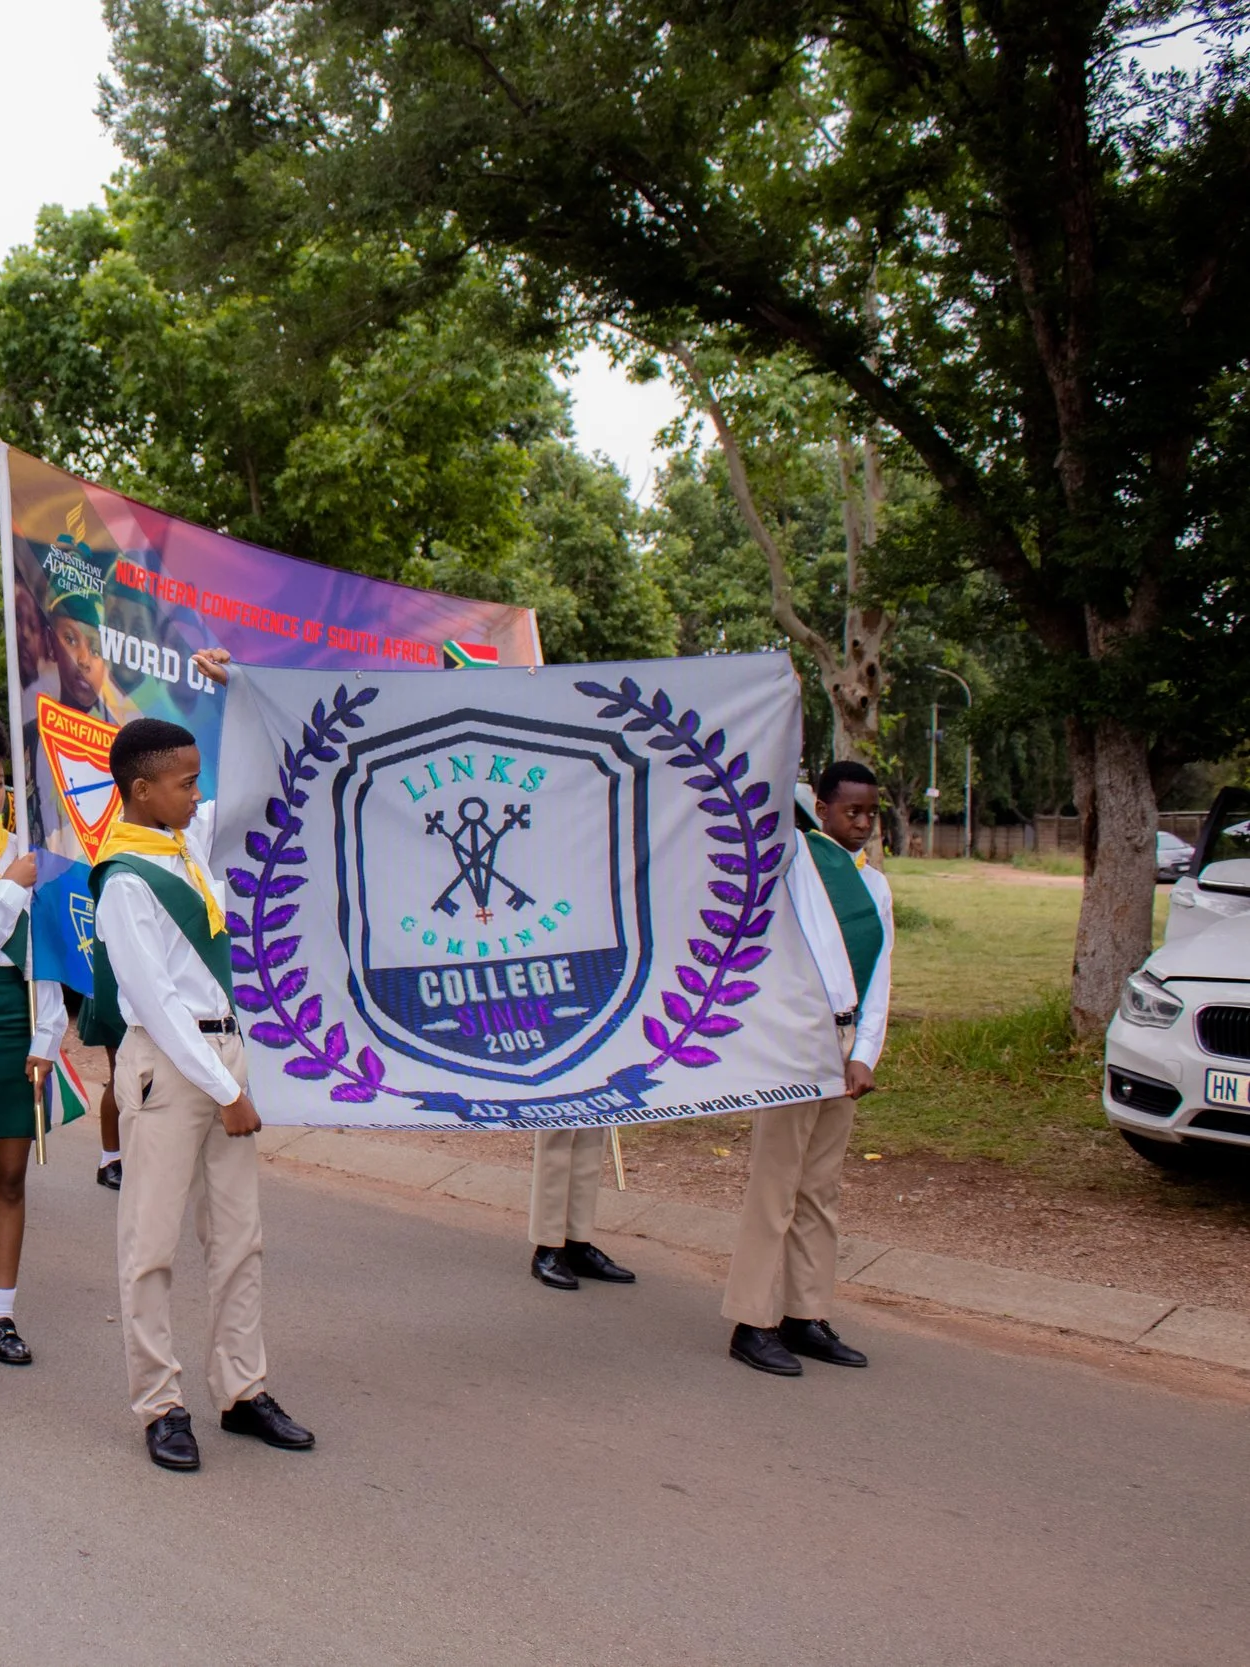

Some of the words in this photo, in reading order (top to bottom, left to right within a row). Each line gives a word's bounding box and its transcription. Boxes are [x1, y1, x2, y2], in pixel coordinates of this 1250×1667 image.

[42, 552, 107, 594] ADVENTIST
[50, 544, 102, 578] SEVENTH-DAY
[57, 577, 90, 599] CHURCH
[115, 559, 198, 610] NORTHERN
[201, 591, 299, 639] CONFERENCE
[303, 619, 324, 644] OF
[327, 625, 378, 656] SOUTH
[382, 637, 438, 667] AFRICA
[98, 624, 180, 684] WORD
[46, 709, 116, 748] PATHFIND
[400, 753, 548, 803] LINKS
[400, 899, 573, 958] COMBINED
[417, 957, 576, 1008] COLLEGE
[456, 997, 554, 1037] SINCE
[483, 1028, 546, 1054] 2009
[578, 1103, 696, 1127] excellence
[694, 1092, 758, 1112] walks
[756, 1083, 823, 1104] boldly
[1213, 1074, 1238, 1102] HN
[469, 1103, 509, 1119] AD
